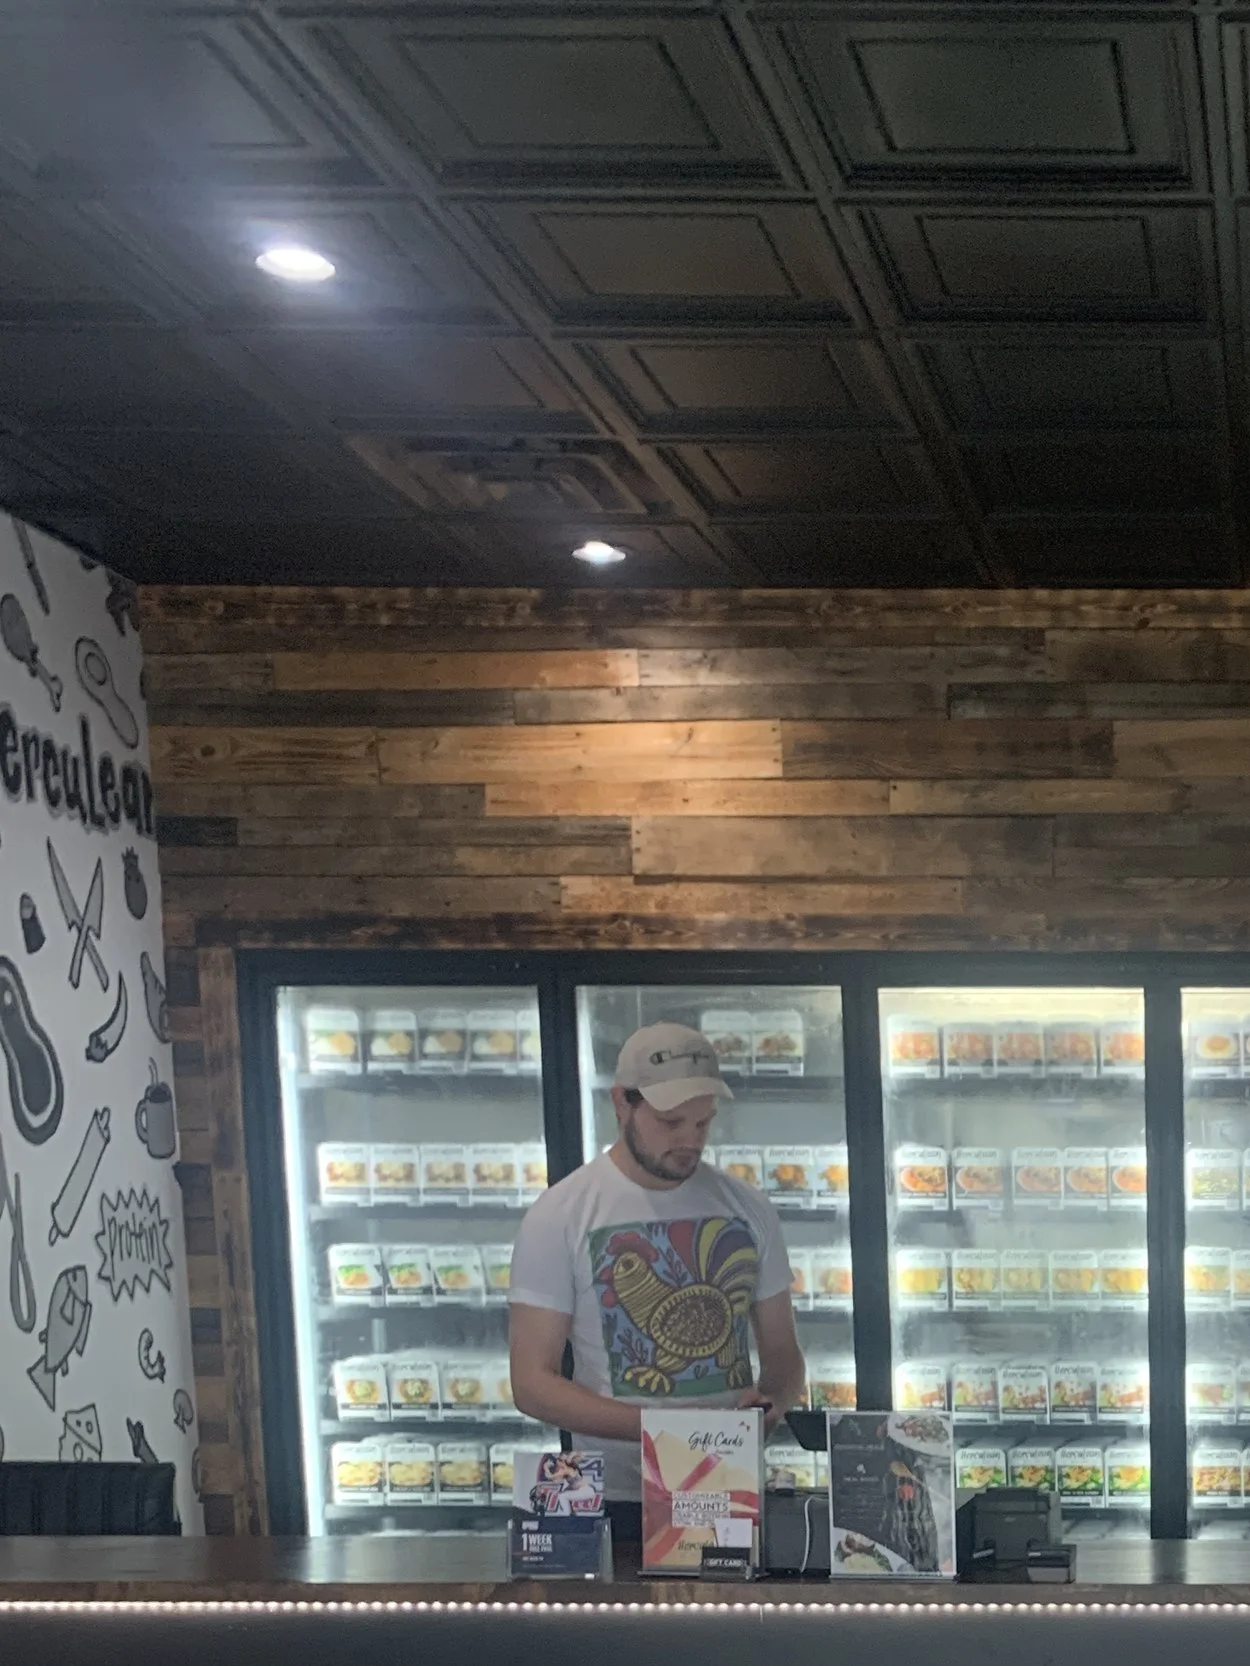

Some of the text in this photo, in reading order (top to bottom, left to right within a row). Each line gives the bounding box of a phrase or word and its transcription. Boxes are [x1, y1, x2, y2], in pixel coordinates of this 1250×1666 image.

[688, 1431, 744, 1452] Gift Cards
[674, 1501, 728, 1511] AMOUNTS
[528, 1533, 553, 1545] WEEK
